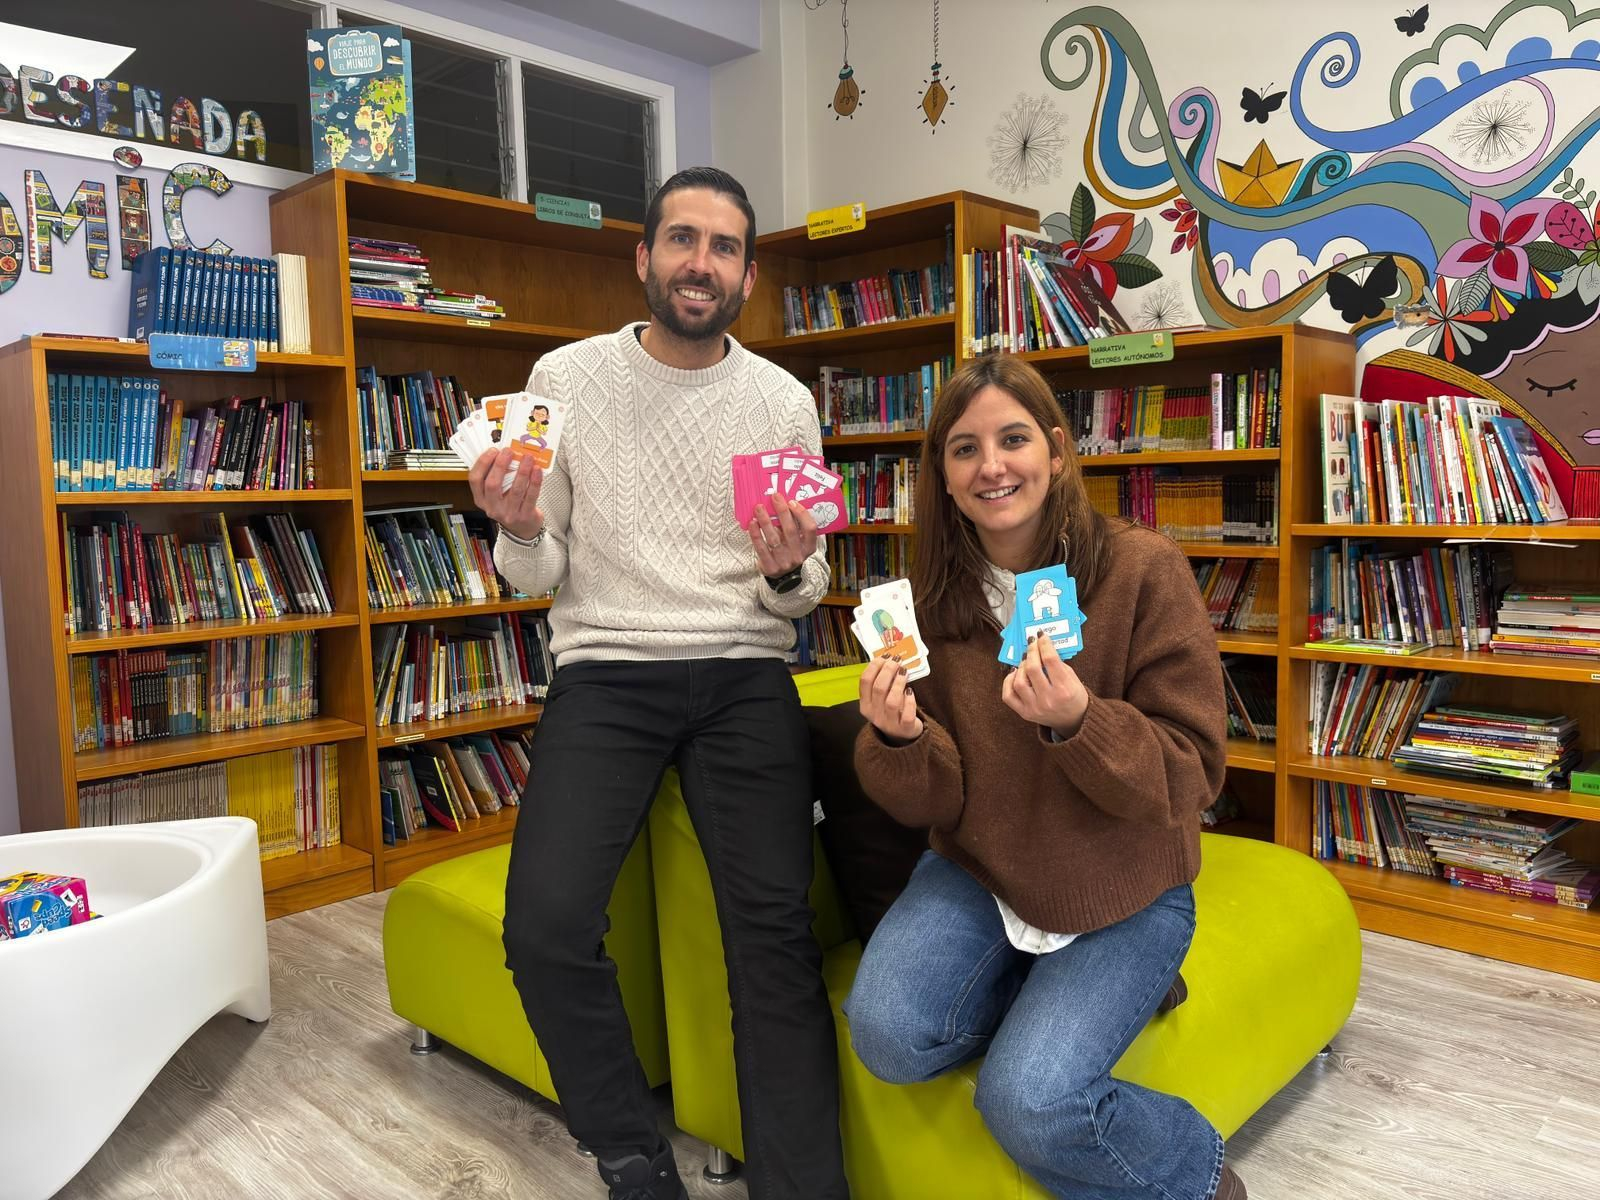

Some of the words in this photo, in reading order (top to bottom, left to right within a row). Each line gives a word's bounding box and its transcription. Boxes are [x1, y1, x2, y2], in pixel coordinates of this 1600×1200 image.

[333, 45, 376, 59] DESCUBRIR
[347, 57, 373, 70] MUNDO
[1091, 345, 1126, 353] NARRATIVA
[33, 902, 60, 922] Cups
[42, 905, 72, 928] Speed
